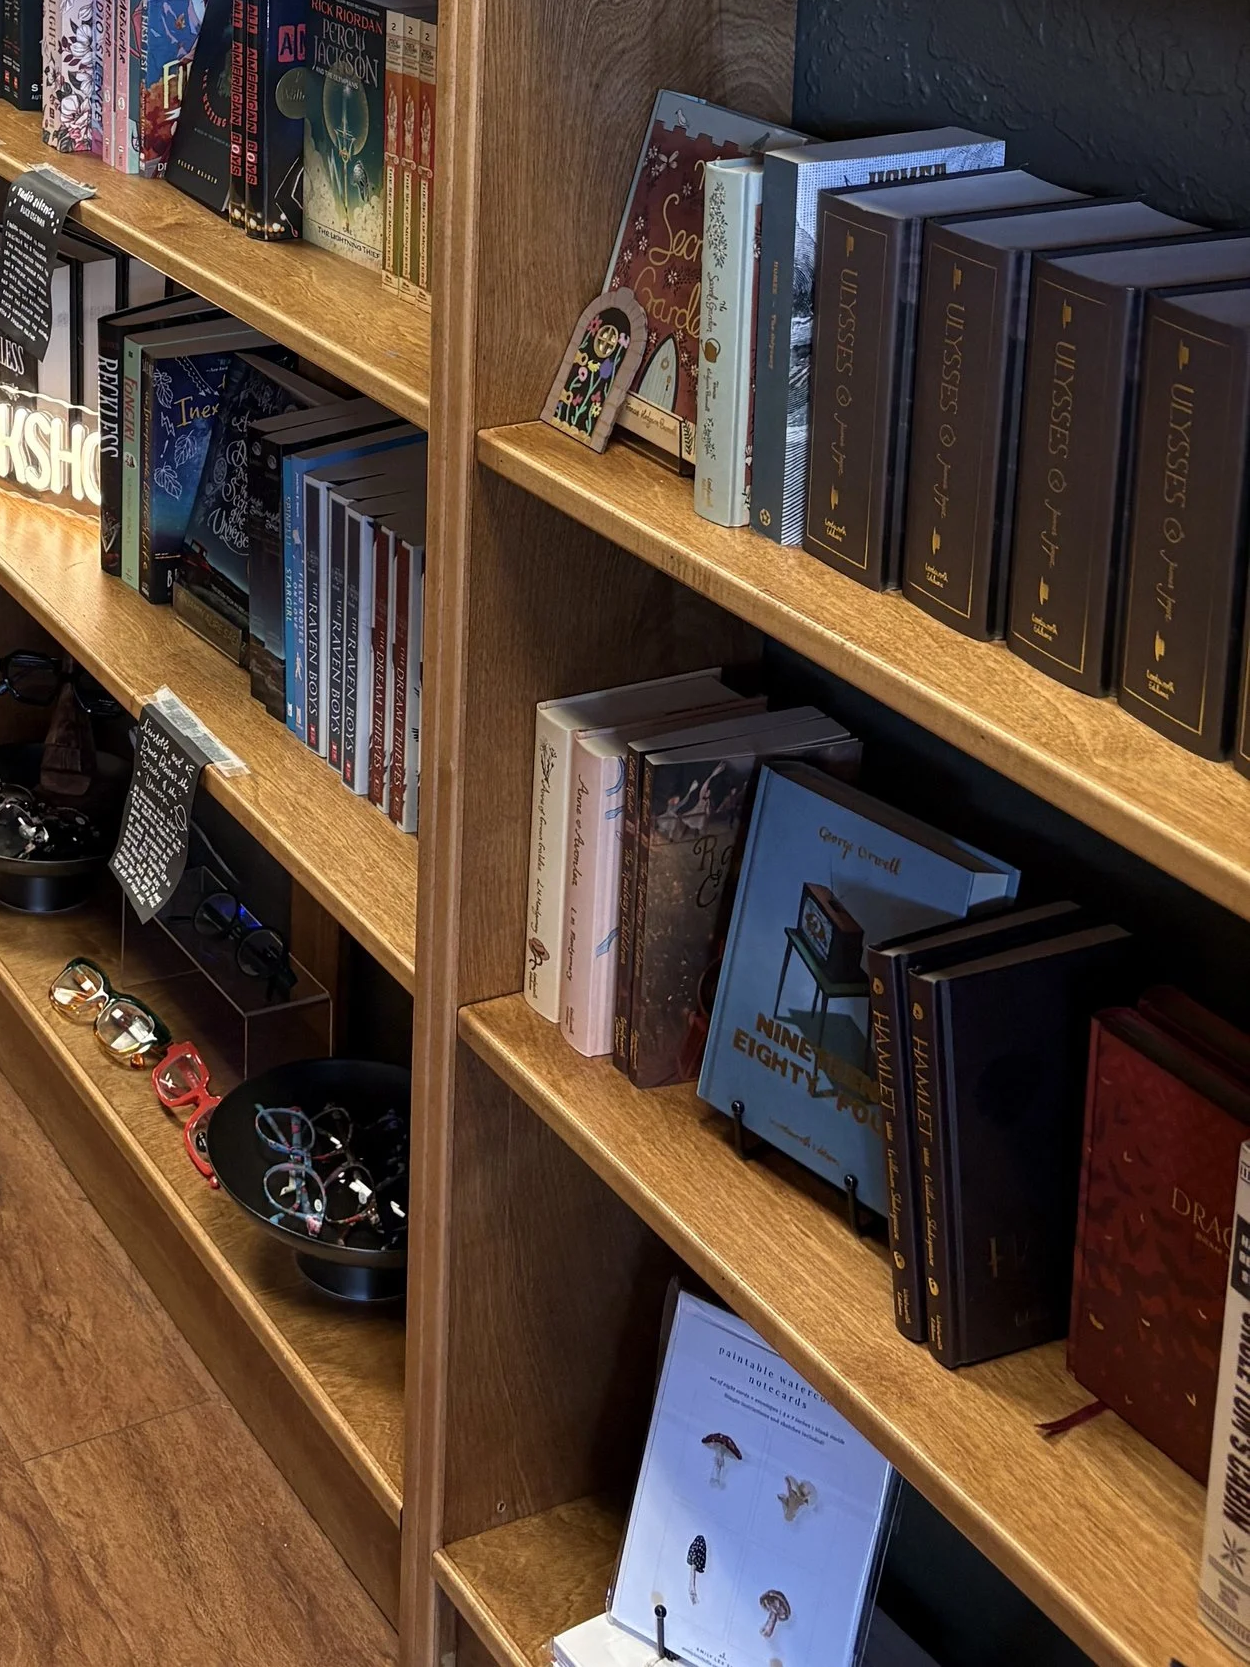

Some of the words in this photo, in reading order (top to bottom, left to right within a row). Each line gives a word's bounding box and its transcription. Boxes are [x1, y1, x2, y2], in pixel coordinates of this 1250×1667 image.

[322, 18, 366, 51] PERCY
[335, 5, 383, 35] RIORDAN
[91, 42, 103, 124] SILENCE
[230, 42, 244, 127] AMERICAN
[312, 35, 379, 88] JACKSON
[246, 47, 258, 136] AMERICAN
[230, 134, 243, 177] BOYS
[245, 140, 258, 186] BOYS
[317, 225, 330, 237] THE
[330, 230, 361, 253] LIGHTNING
[362, 245, 380, 260] THIEF
[835, 267, 859, 378] ULYSSES
[939, 301, 966, 414] ULYSSES
[173, 396, 220, 427] Inex
[1047, 339, 1077, 460] ULYSSES
[1164, 382, 1195, 509] ULYSSES
[285, 567, 293, 623] STARGIRL
[307, 603, 319, 665] RAVEN
[332, 619, 342, 684] RAVEN
[308, 671, 318, 717] BOYS
[346, 638, 358, 699] RAVEN
[375, 649, 386, 705] DREAM
[396, 663, 406, 722] DREAM
[331, 689, 341, 735] BOYS
[345, 705, 355, 753] BOYS
[373, 708, 383, 770] THIEVES
[393, 725, 405, 788] THIEVES
[577, 774, 590, 815] Anne
[570, 828, 586, 886] Avonlea
[819, 826, 854, 861] George
[858, 847, 901, 876] Orwell
[872, 1009, 895, 1117] HAMLET
[912, 1035, 934, 1142] HAMLET
[719, 1347, 774, 1379] paintable
[780, 1376, 829, 1405] waterco
[749, 1376, 807, 1409] notecards
